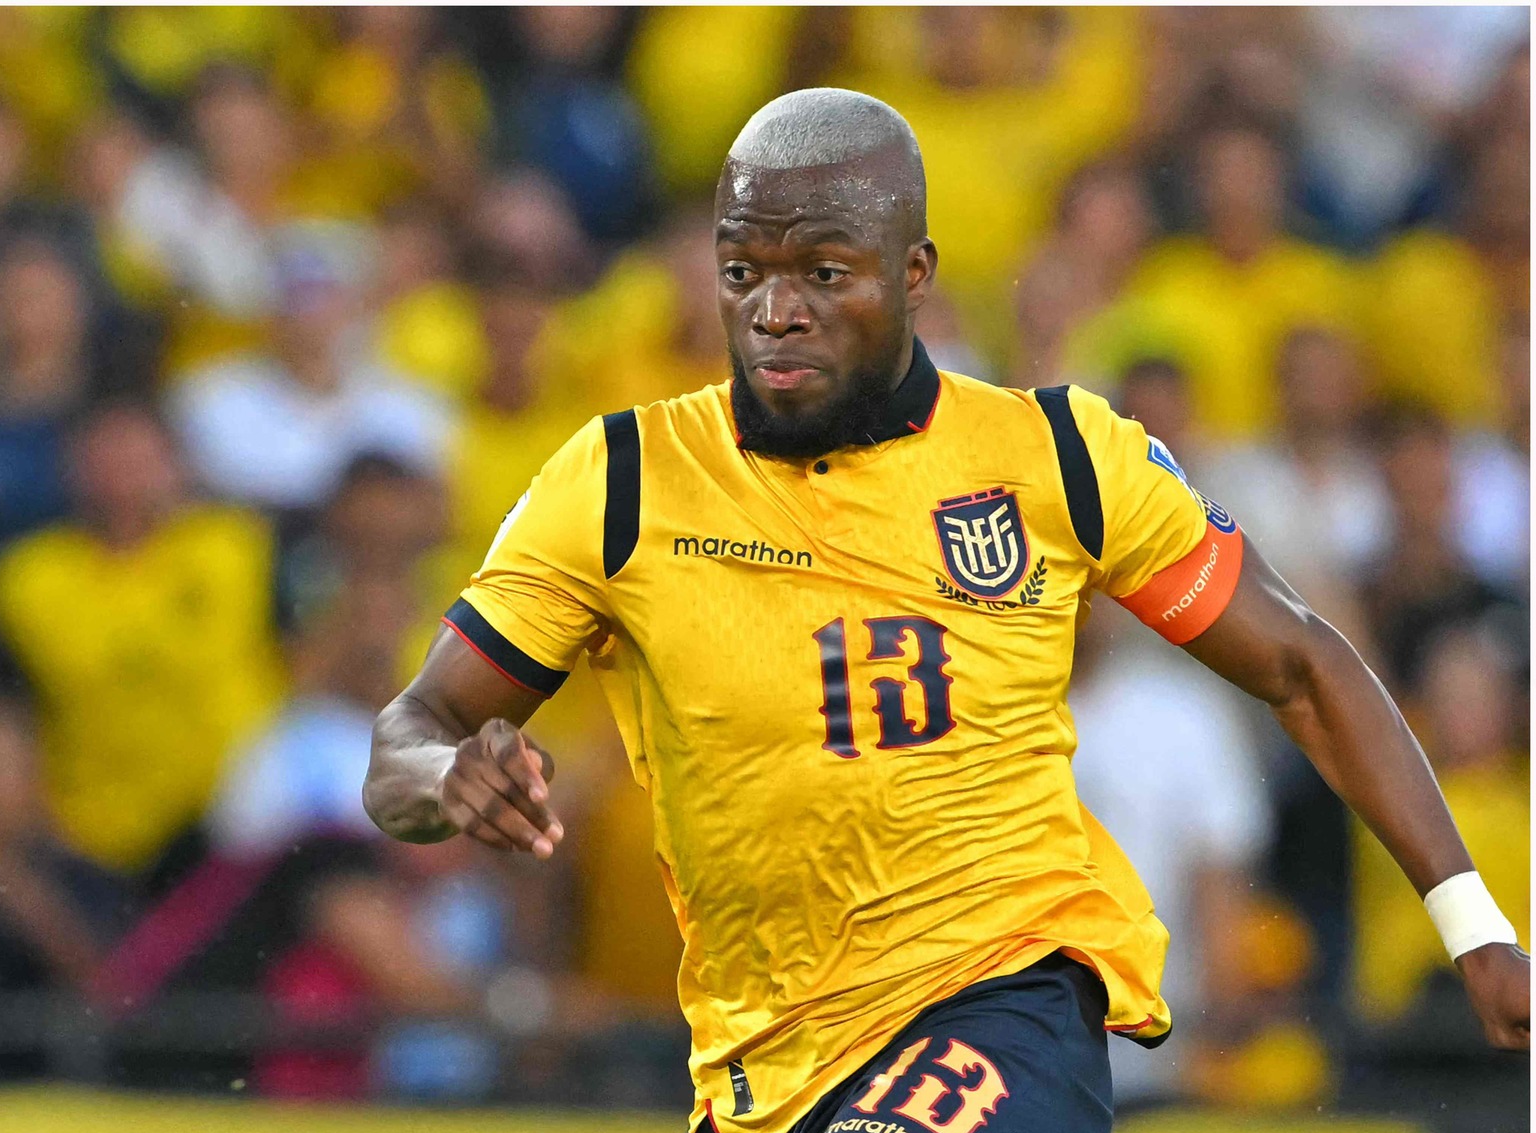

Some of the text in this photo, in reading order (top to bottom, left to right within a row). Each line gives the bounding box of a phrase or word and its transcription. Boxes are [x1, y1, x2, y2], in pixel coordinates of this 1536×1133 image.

[673, 537, 812, 568] marathon
[1161, 542, 1220, 623] marathon
[811, 615, 957, 759] 13
